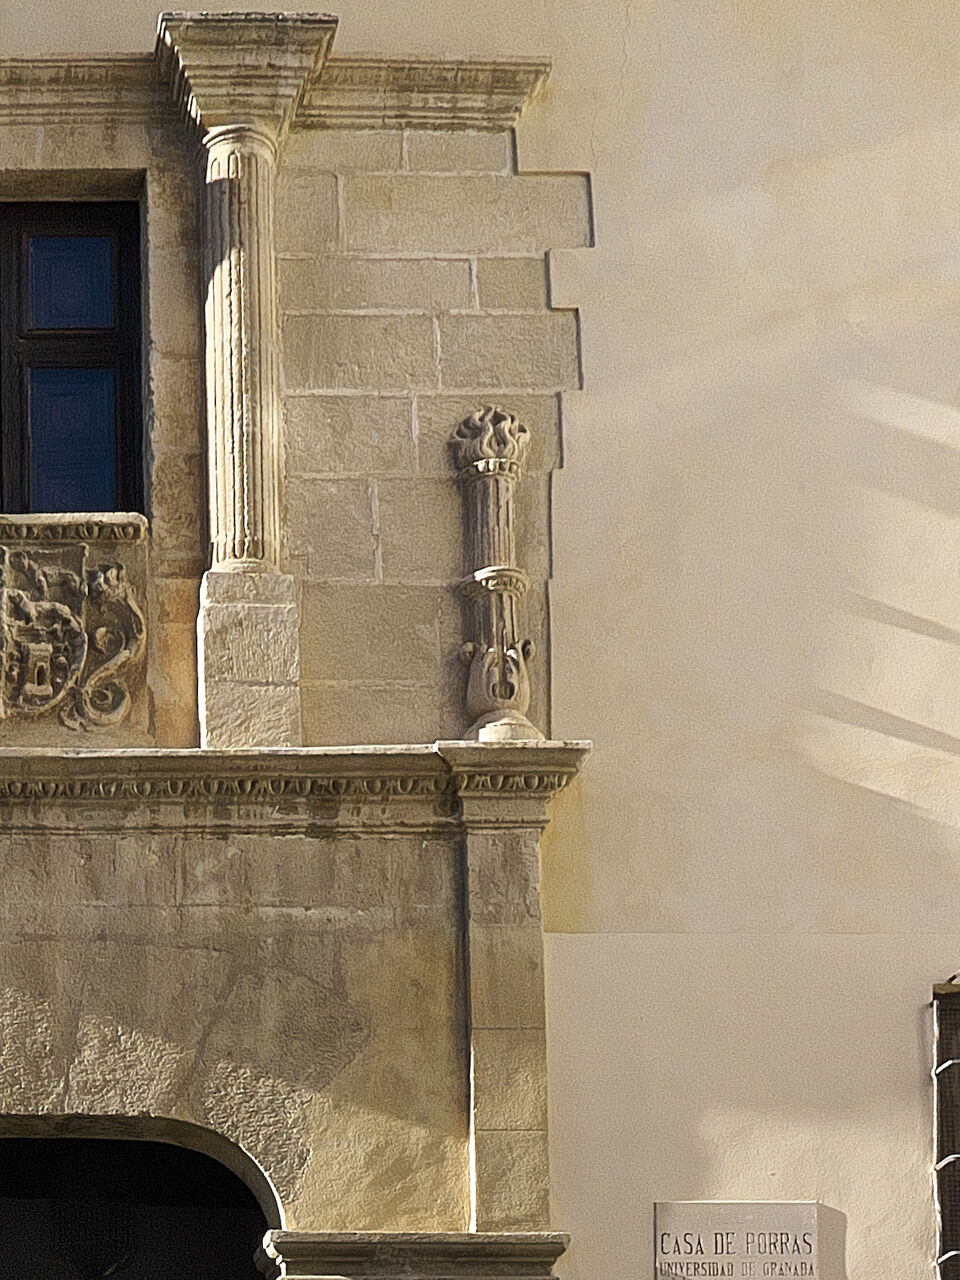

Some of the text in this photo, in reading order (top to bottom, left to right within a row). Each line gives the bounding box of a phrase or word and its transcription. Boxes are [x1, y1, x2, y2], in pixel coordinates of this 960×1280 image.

[660, 1232, 813, 1256] CASA DE PORRAS
[659, 1261, 815, 1277] UNIVERSIDAD DE GRANADA
